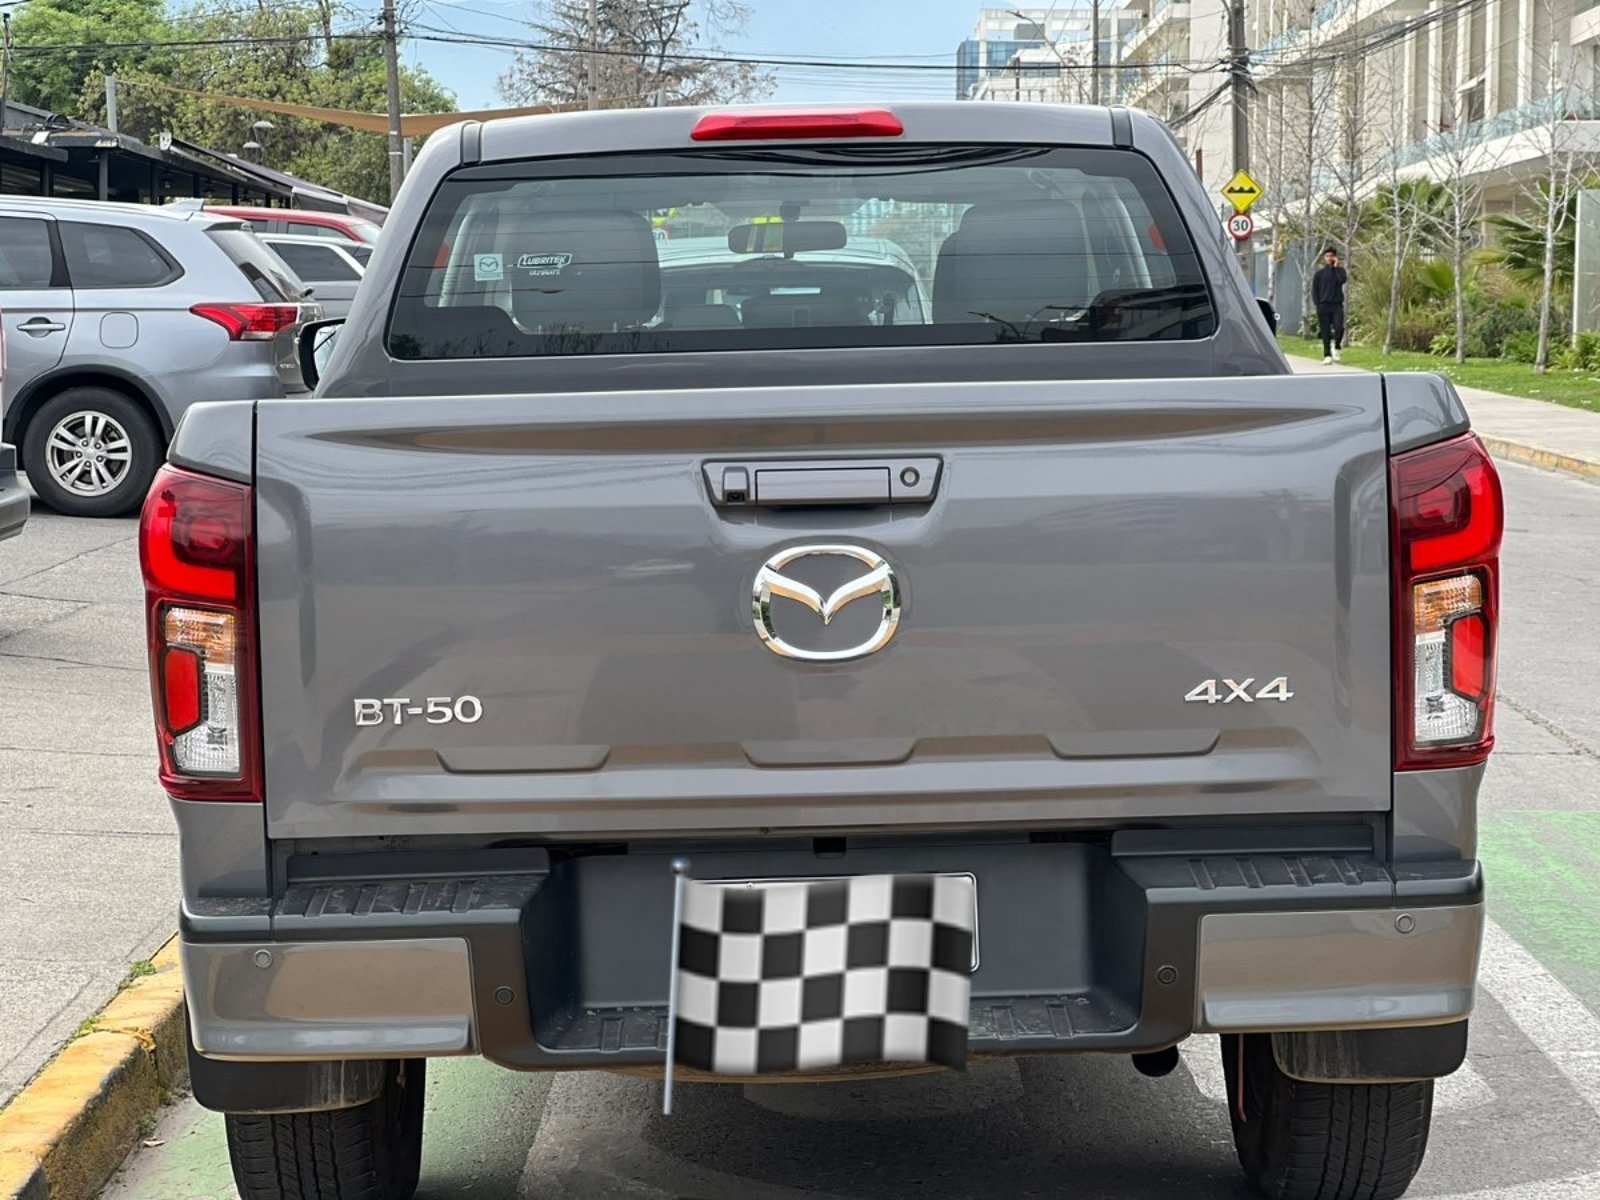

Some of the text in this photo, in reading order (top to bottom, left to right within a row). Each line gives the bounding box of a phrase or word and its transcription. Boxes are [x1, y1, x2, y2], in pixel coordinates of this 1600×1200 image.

[1233, 219, 1249, 232] 30
[522, 254, 568, 266] LUBRITEK
[1184, 676, 1295, 704] 4X4
[353, 695, 483, 726] BT-50
